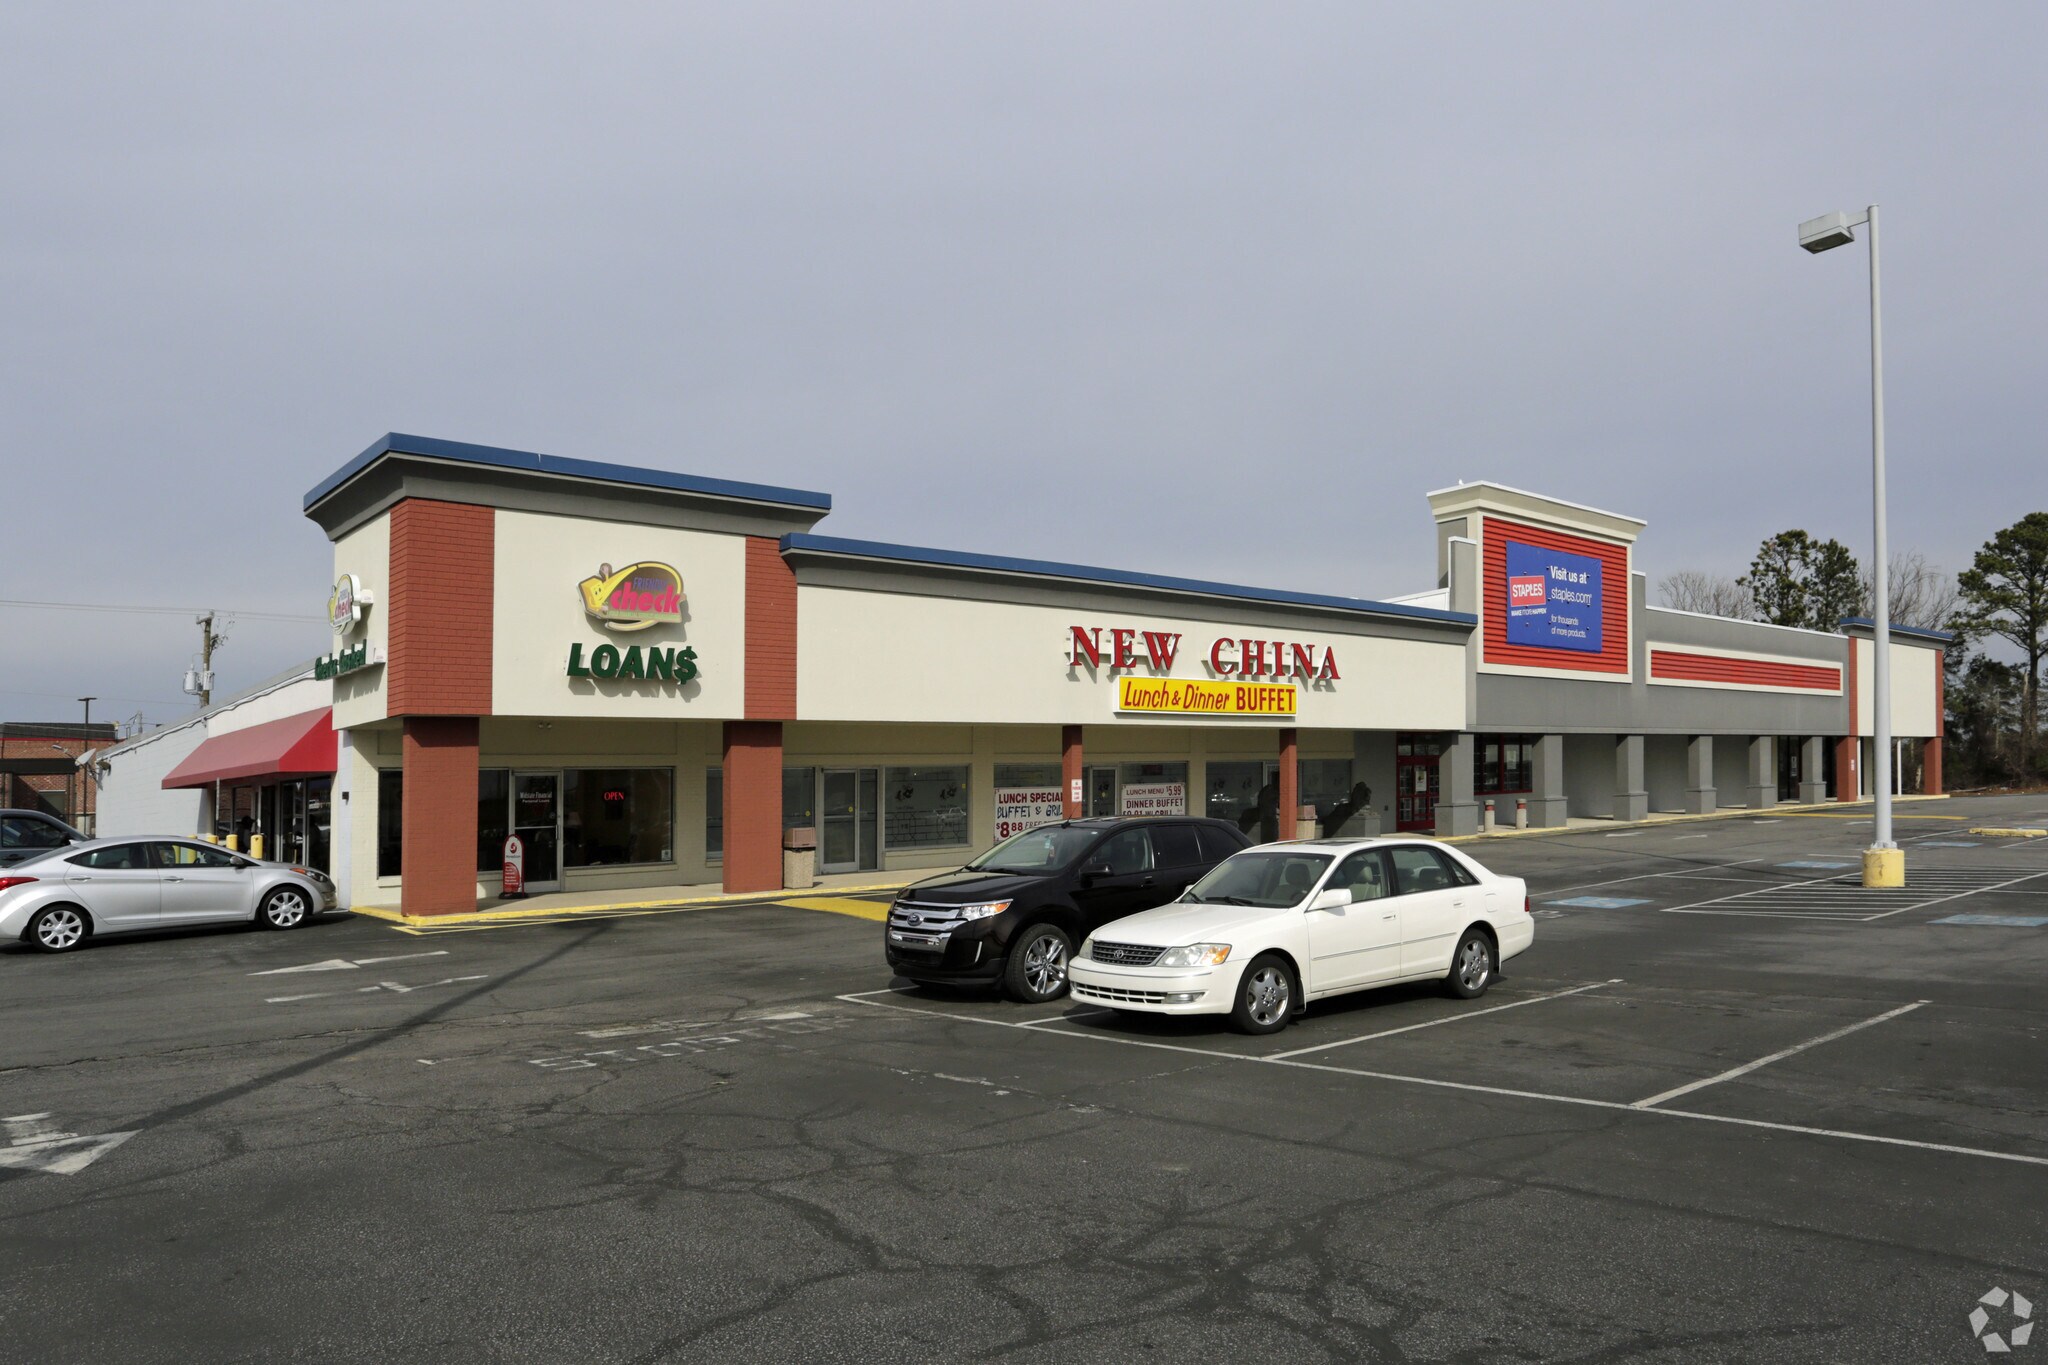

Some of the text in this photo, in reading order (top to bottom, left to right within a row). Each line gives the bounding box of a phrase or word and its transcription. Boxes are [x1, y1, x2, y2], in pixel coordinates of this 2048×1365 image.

[1550, 565, 1587, 584] Visit us at
[610, 581, 680, 614] check
[1512, 583, 1543, 598] STAPLES
[1558, 614, 1579, 625] thousands
[1557, 628, 1567, 636] more
[1069, 626, 1341, 679] NEW CHINA
[566, 642, 698, 685] LOAN$
[1124, 681, 1295, 711] Lunch & Dinner BUFFET
[604, 791, 624, 801] OPEN
[998, 793, 1027, 804] LUNCH
[1126, 788, 1146, 796] LUNCH
[1126, 798, 1183, 809] DINNER BUFFET
[997, 805, 1031, 819] BUFFET
[1035, 806, 1042, 815] &
